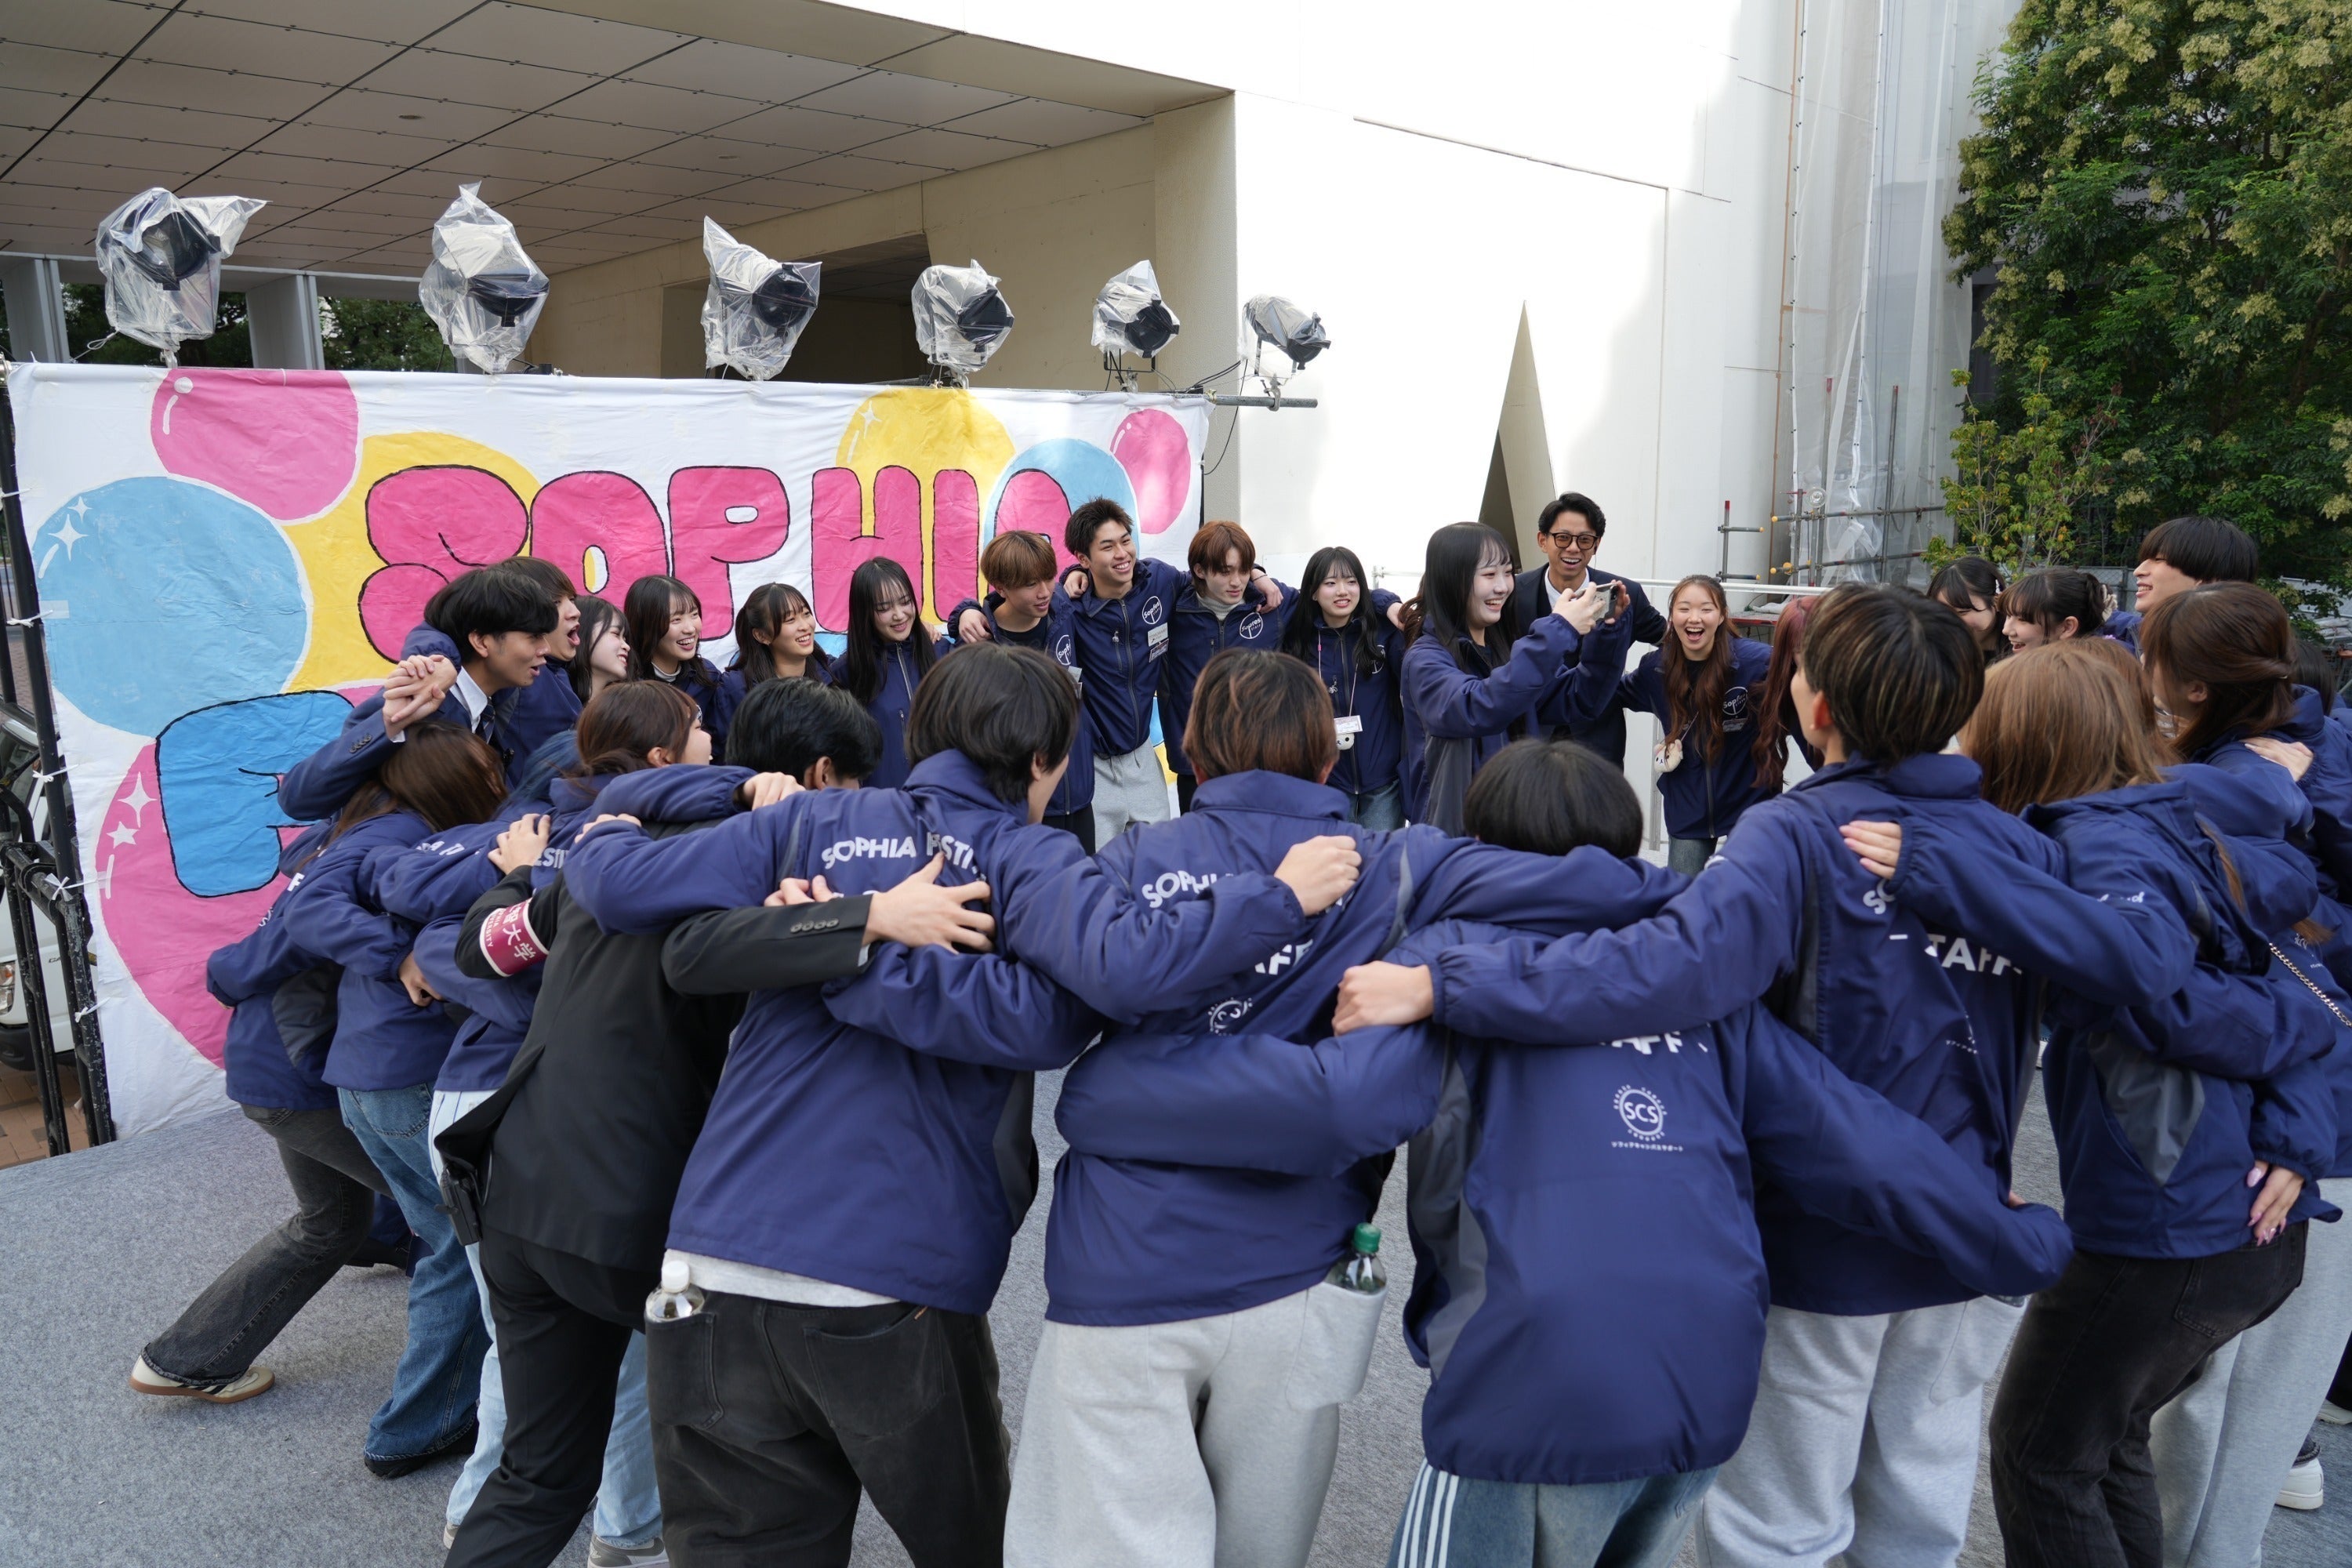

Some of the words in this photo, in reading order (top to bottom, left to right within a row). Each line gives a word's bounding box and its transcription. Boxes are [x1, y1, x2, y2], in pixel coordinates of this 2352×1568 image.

[821, 836, 917, 870] SOPHIA
[1142, 870, 1218, 908] SOPHI
[1624, 1102, 1659, 1124] SCS
